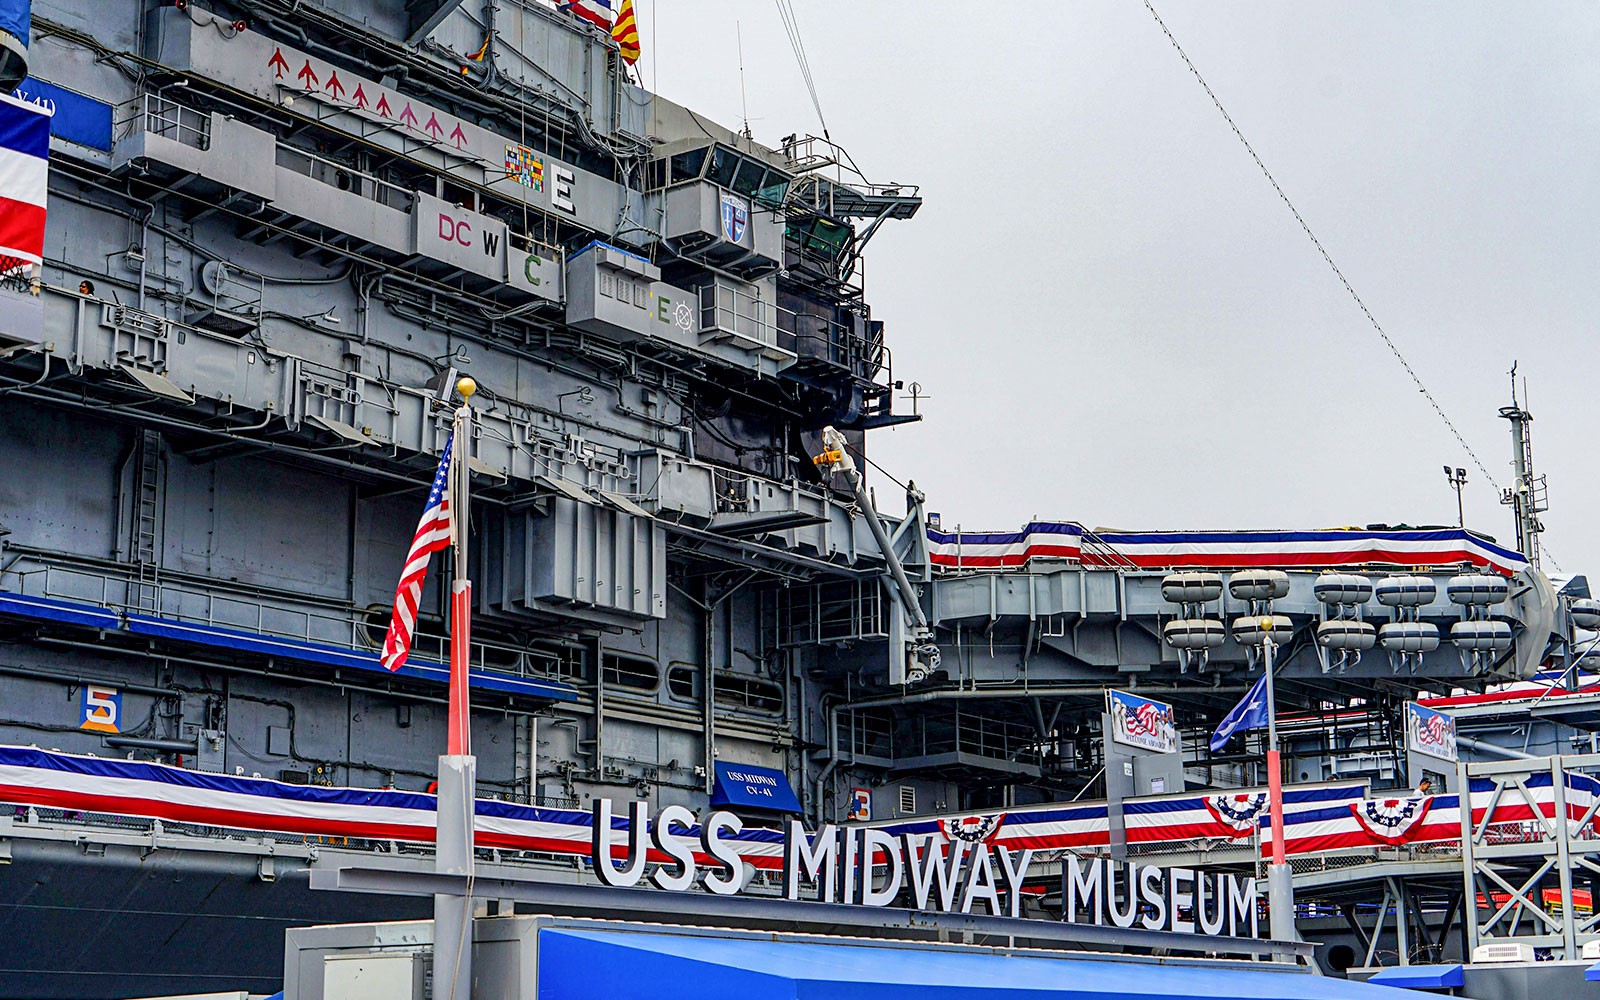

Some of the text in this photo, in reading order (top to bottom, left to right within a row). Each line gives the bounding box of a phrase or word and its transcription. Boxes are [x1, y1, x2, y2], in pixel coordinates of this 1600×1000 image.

[551, 163, 575, 215] E
[438, 213, 499, 257] DC W
[524, 254, 541, 287] C
[658, 295, 670, 325] E
[86, 685, 117, 725] 5
[726, 770, 777, 787] USS MIDWAY
[855, 790, 871, 821] 3
[592, 798, 1259, 939] USS MIDWAY MUSEUM
